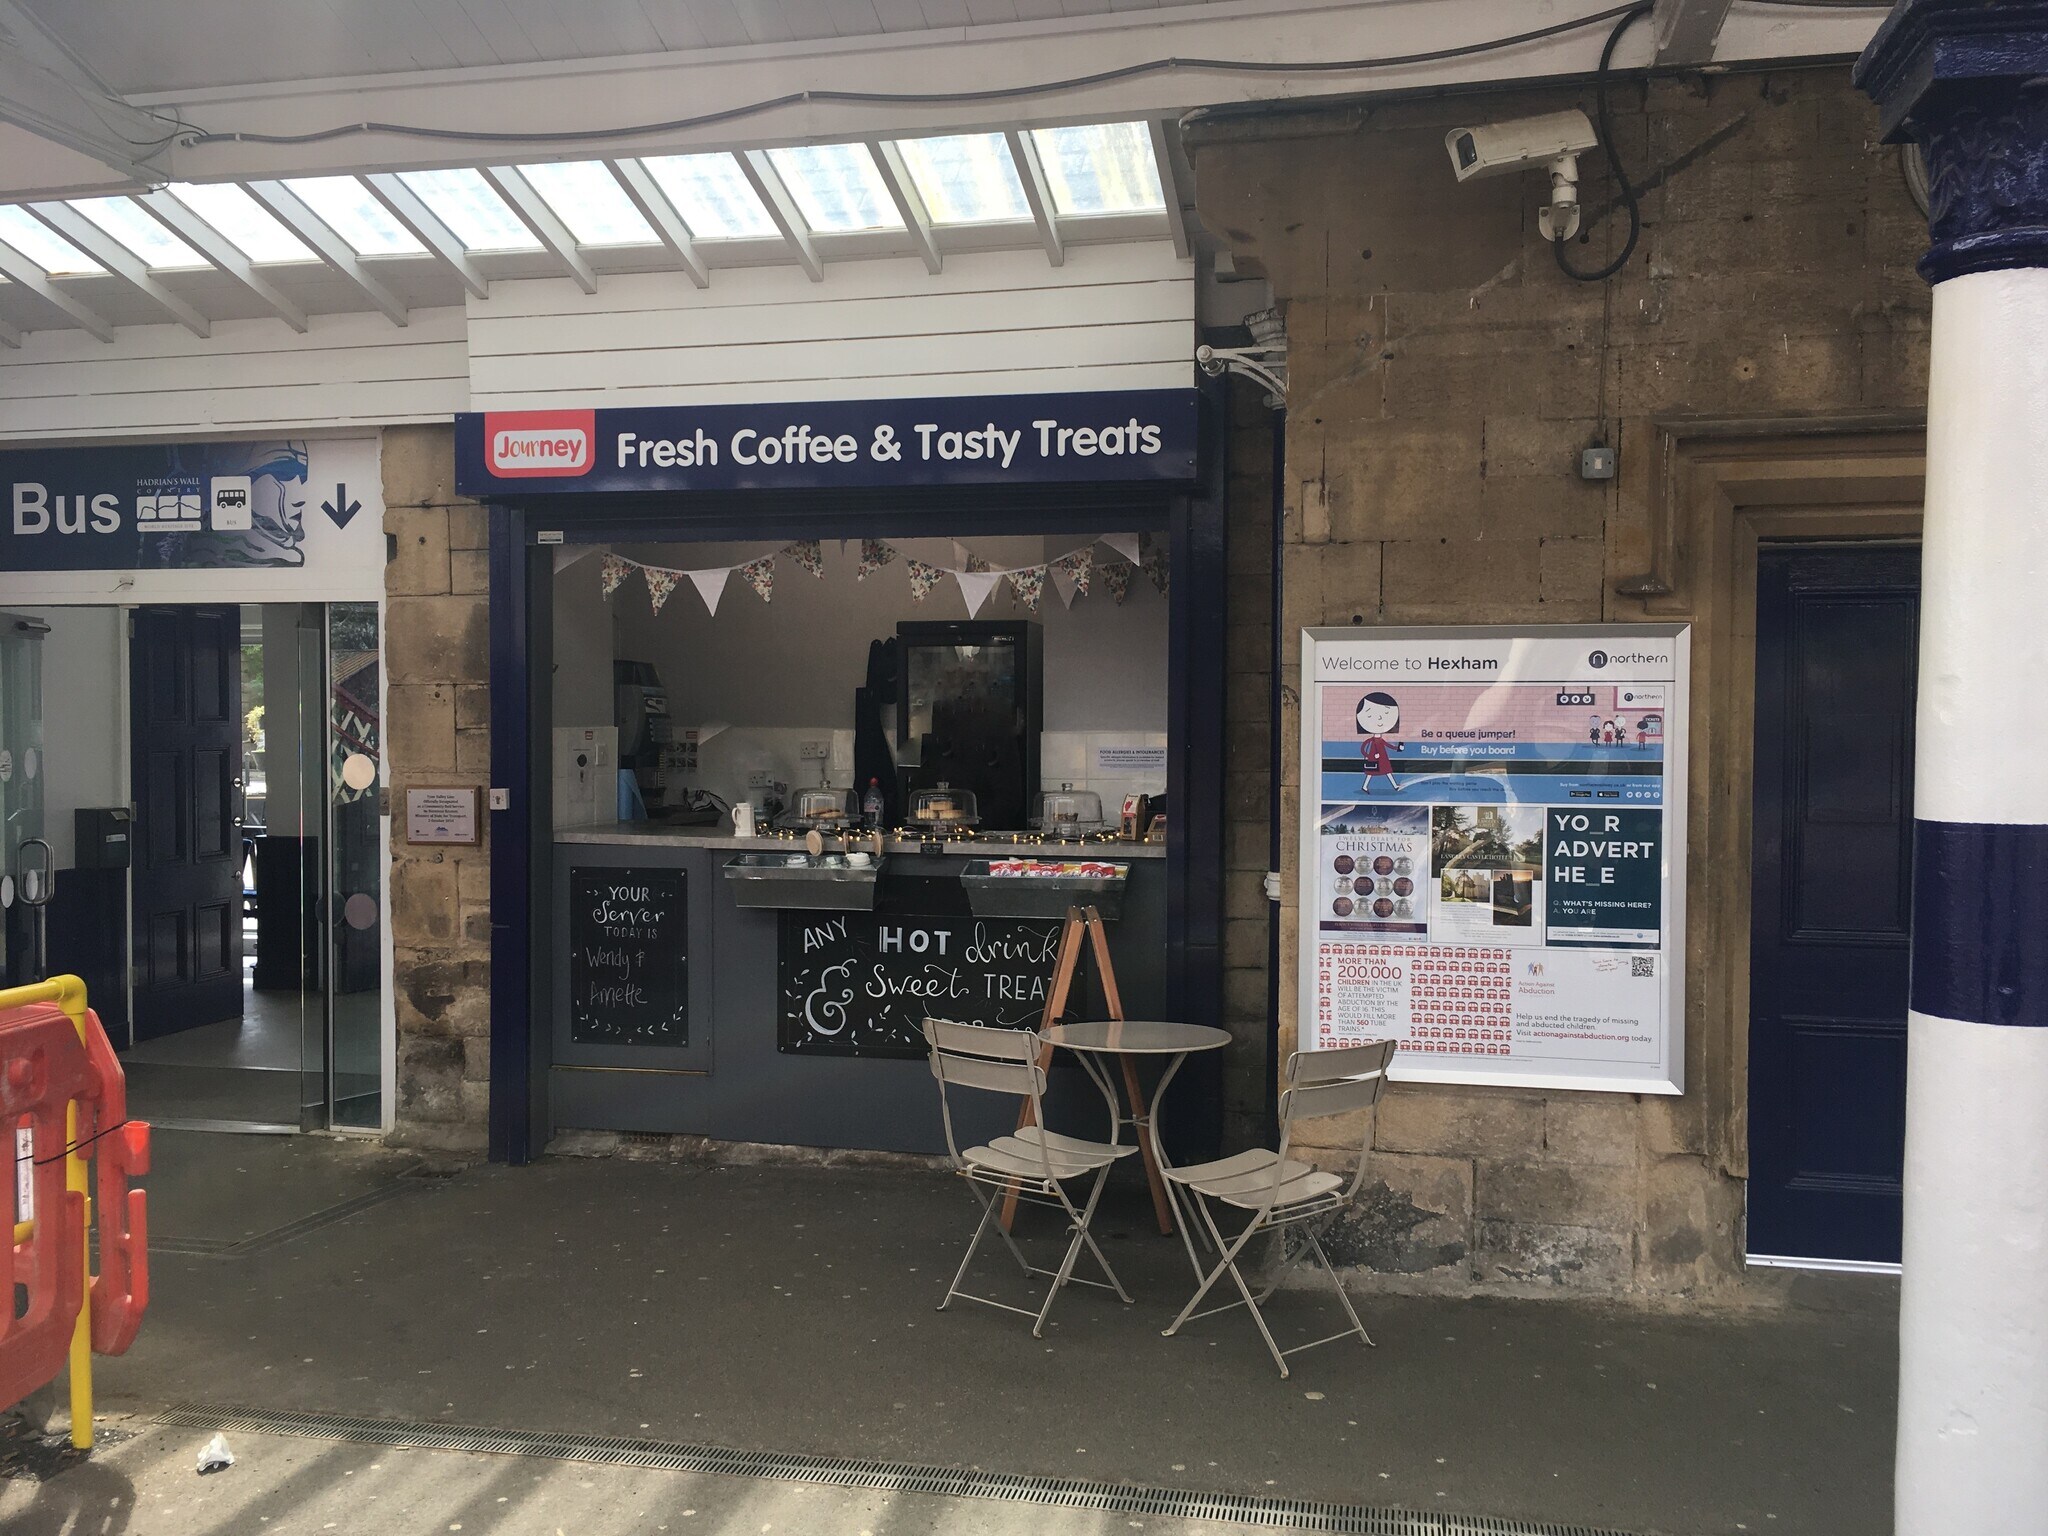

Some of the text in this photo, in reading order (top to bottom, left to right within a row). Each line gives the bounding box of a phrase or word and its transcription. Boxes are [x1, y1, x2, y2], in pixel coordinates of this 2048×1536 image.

[498, 435, 582, 463] Journey
[617, 417, 1162, 469] Fresh Coffee & Tasty Treats
[137, 478, 178, 487] HADRIAN'S
[13, 482, 121, 535] Bus
[1322, 656, 1498, 670] Welcome to Hexham
[1610, 653, 1668, 663] northern
[1421, 730, 1516, 740] Be a queue jumper!
[1421, 745, 1515, 756] Buy before you board
[1554, 814, 1620, 835] YO_R
[1336, 841, 1413, 853] CHRISTMAS
[1554, 840, 1654, 858] ADVERT
[1554, 866, 1615, 887] HE_E
[609, 886, 650, 901] YOUR
[593, 900, 664, 925] Server
[604, 926, 658, 939] TODAY IS
[803, 916, 850, 953] ANY
[879, 926, 951, 955] HOT
[586, 946, 630, 980] Wendy
[1337, 957, 1362, 965] MORE
[1338, 965, 1402, 979] 200,000
[805, 958, 1052, 1036] & Sweet TREA
[1518, 987, 1555, 995] Abduction
[1516, 1013, 1533, 1021] Help
[1559, 1014, 1572, 1022] the
[1573, 1015, 1600, 1024] tragedy
[1611, 1018, 1639, 1026] missing
[1531, 1021, 1565, 1029] abducted
[1516, 1029, 1532, 1037] Visit
[1533, 1031, 1630, 1042] actionagainstabduction.org
